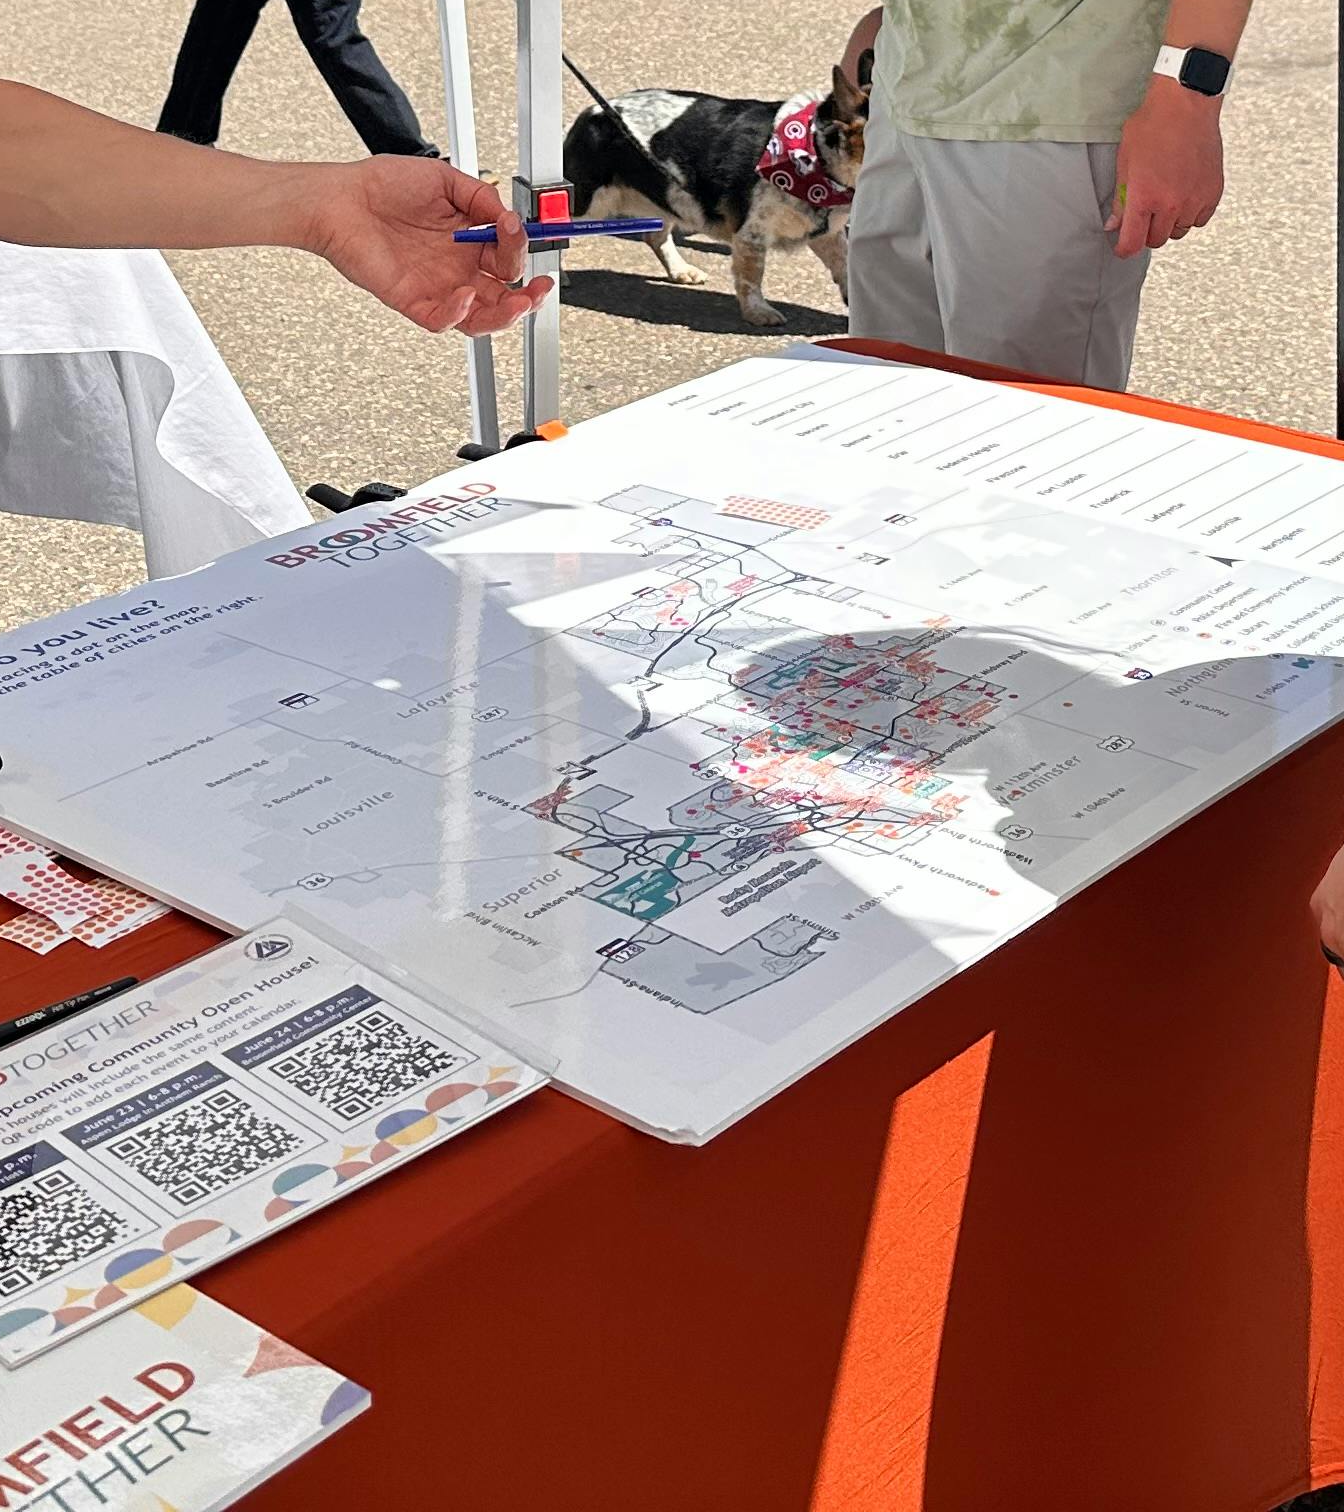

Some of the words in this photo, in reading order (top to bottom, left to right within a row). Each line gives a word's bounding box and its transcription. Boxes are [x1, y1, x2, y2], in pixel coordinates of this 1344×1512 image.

[265, 482, 496, 568] BROOMFIELD
[318, 496, 512, 568] TOGETHER
[1260, 526, 1307, 552] Northglenn
[1120, 565, 1180, 597] Thornton
[1245, 588, 1286, 615] Emergency
[1281, 575, 1312, 593] Services
[1169, 590, 1213, 616] Community
[1213, 579, 1236, 595] Center
[1212, 586, 1259, 612] Department
[20, 629, 88, 657] you
[86, 599, 165, 630] live?
[31, 661, 81, 682] table
[84, 651, 104, 664] of
[107, 633, 156, 655] cities
[160, 624, 182, 636] on
[184, 611, 214, 625] the
[216, 595, 265, 614] right.
[55, 654, 67, 662] a
[70, 640, 103, 656] dot
[106, 631, 128, 644] on
[130, 620, 160, 634] the
[162, 605, 208, 622] map,
[1239, 620, 1271, 636] Library
[1165, 656, 1238, 697] Northglenn
[397, 679, 480, 719] Lafayette
[480, 708, 502, 721] 287
[1195, 703, 1230, 718] Huron
[146, 742, 197, 766] Arapahoe
[205, 767, 253, 788] Baseline
[997, 755, 1082, 809] Westminster
[1003, 769, 1030, 786] 112th
[271, 783, 315, 805] Boulder
[1071, 810, 1084, 821] W
[1084, 797, 1108, 813] 104th
[1108, 787, 1126, 799] Ave
[302, 790, 395, 835] Louisville
[938, 827, 966, 840] Blvd
[896, 854, 928, 870] Pkwy
[969, 838, 1033, 865] Wadsworth
[306, 875, 326, 888] 36
[482, 866, 563, 914] Superior
[464, 910, 491, 926] Blvd
[523, 893, 567, 920] Coalton
[565, 884, 585, 898] Rd
[841, 912, 857, 922] W
[858, 895, 883, 914] 108th
[491, 922, 542, 947] McCaslin
[802, 918, 841, 939] Simms
[613, 944, 642, 963] 128
[640, 985, 683, 1008] Indiana
[87, 1015, 199, 1073] Community
[201, 989, 254, 1019] Open
[253, 956, 320, 993] House!
[243, 1034, 274, 1055] June
[273, 1026, 292, 1039] 24
[303, 1007, 326, 1023] 6-8
[326, 995, 355, 1014] p.m.
[293, 1012, 344, 1041] Community
[2, 1131, 25, 1146] QR
[27, 1113, 64, 1135] code
[66, 1103, 84, 1117] to
[85, 1089, 114, 1107] add
[114, 1071, 150, 1090] each
[150, 1059, 191, 1078] event
[193, 1044, 208, 1057] to
[210, 1028, 240, 1048] your
[241, 997, 301, 1031] calendar.
[6, 1102, 58, 1128] houses
[59, 1089, 87, 1106] will
[90, 1063, 141, 1088] include
[142, 1050, 167, 1066] the
[168, 1032, 205, 1052] same
[206, 1004, 262, 1035] content.
[80, 1128, 112, 1146] Aspen
[112, 1113, 143, 1132] Lodge
[154, 1086, 194, 1111] Anthem
[83, 1113, 115, 1134] June
[115, 1103, 135, 1116] 23
[147, 1087, 170, 1102] 6-8
[172, 1073, 202, 1092] p.m.
[3, 1152, 38, 1172] p.m.
[11, 1407, 211, 1512] THER
